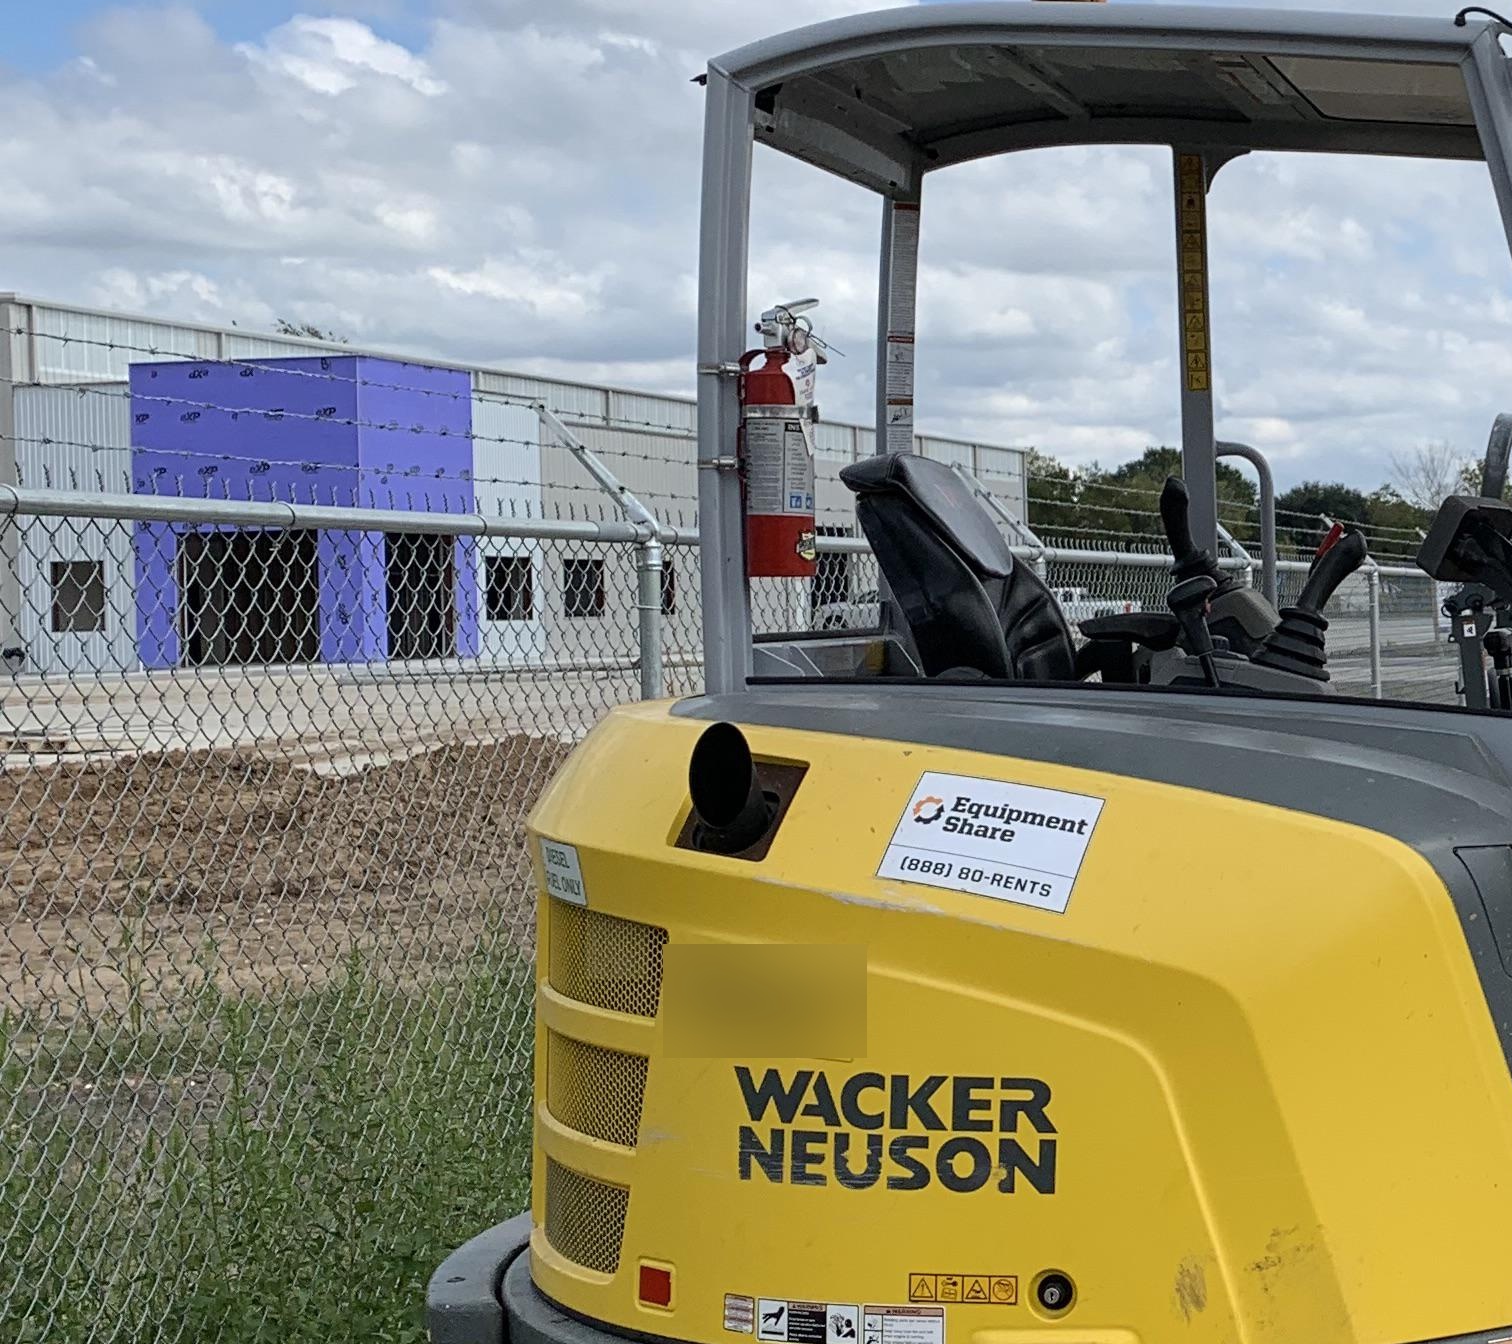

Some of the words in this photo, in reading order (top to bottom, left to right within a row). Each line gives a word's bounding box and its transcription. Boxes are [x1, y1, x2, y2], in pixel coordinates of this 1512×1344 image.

[941, 815, 1016, 843] Share
[951, 795, 1088, 836] Equipment
[899, 855, 953, 878] (888)
[957, 866, 1052, 898] 80-RENTS
[733, 1065, 1059, 1134] WACKER
[738, 1125, 1058, 1195] NEUSON
